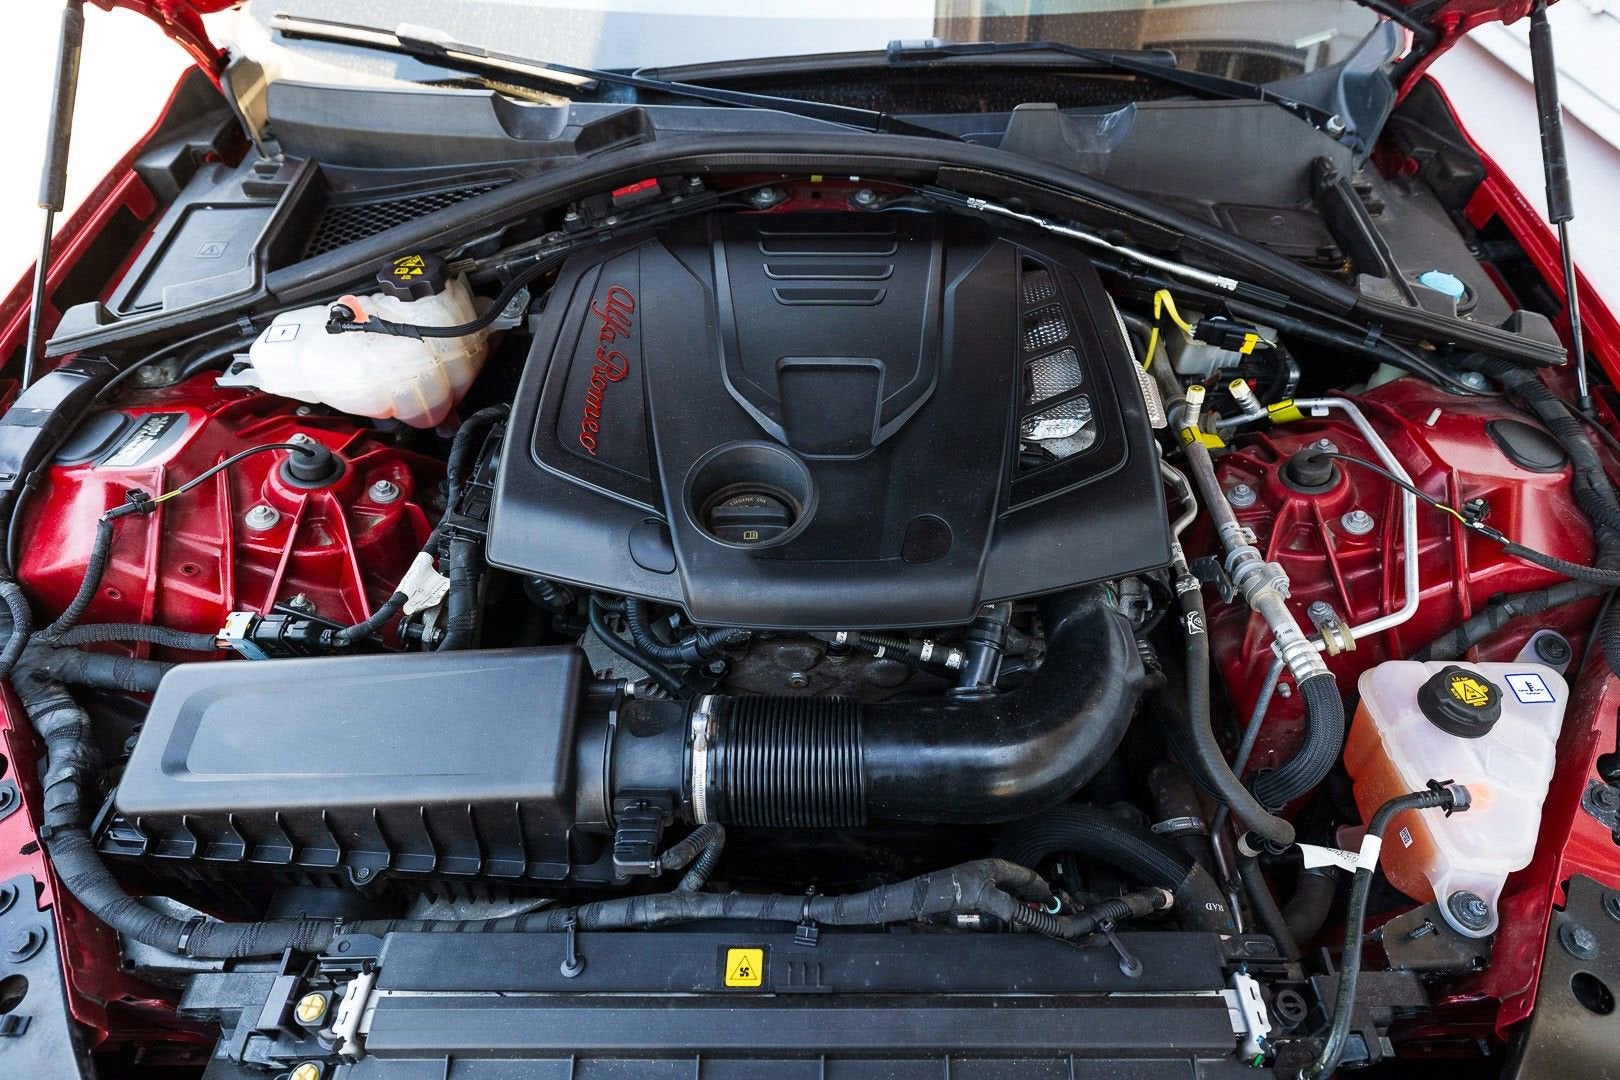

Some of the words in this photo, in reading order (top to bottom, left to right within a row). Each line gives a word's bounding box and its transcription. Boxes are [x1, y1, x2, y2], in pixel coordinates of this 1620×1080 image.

[591, 285, 636, 344] Alfa
[579, 345, 630, 456] Romeo
[730, 497, 754, 506] ENGINE
